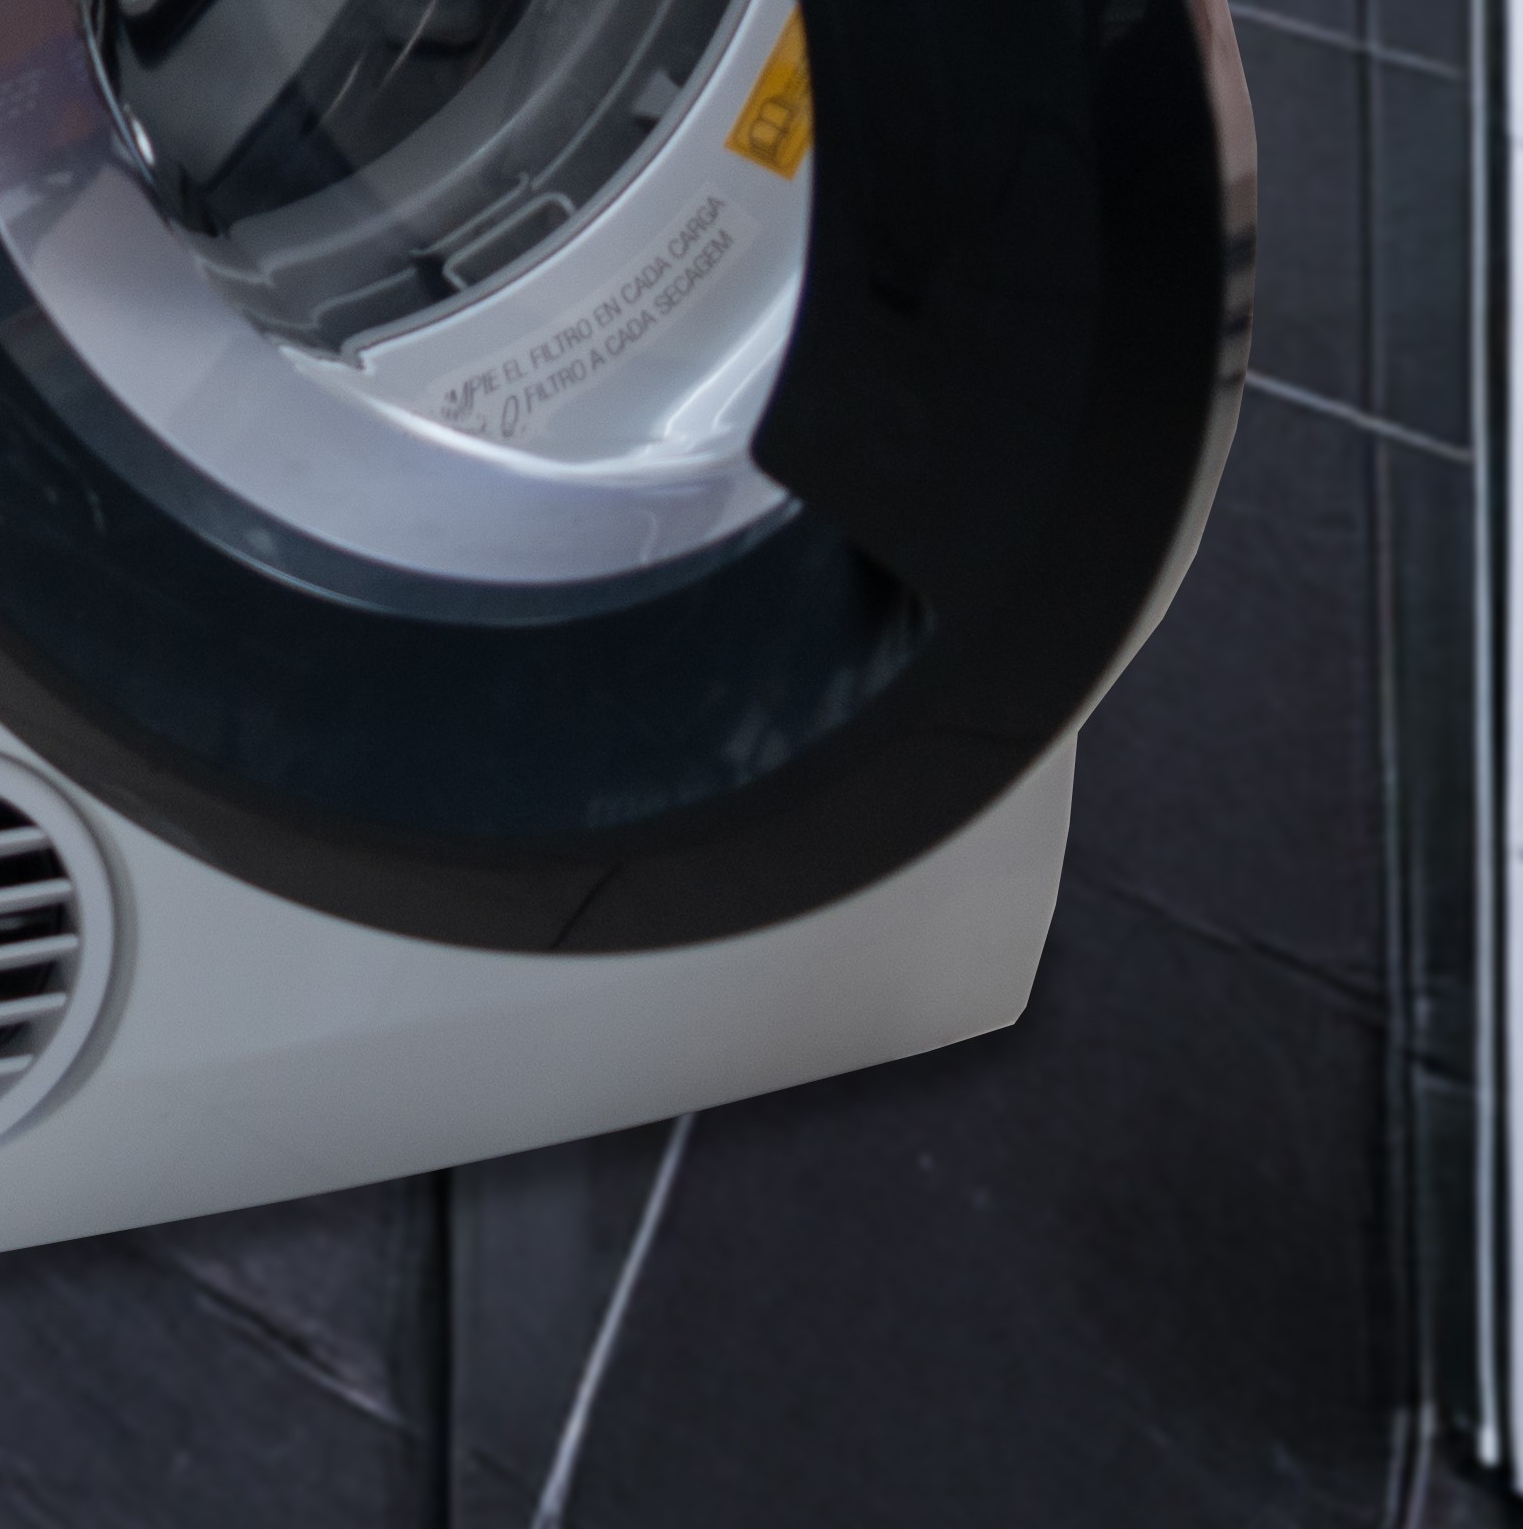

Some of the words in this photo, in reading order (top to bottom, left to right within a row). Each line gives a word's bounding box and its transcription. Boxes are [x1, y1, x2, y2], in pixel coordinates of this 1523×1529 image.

[524, 358, 588, 415] FILTRO
[589, 349, 606, 372] A
[604, 310, 657, 357] CADA
[653, 228, 735, 317] SECAGEM
[529, 317, 594, 370] FILTRO
[593, 296, 622, 327] EN
[620, 256, 672, 305] CADA
[668, 195, 726, 260] CARGA
